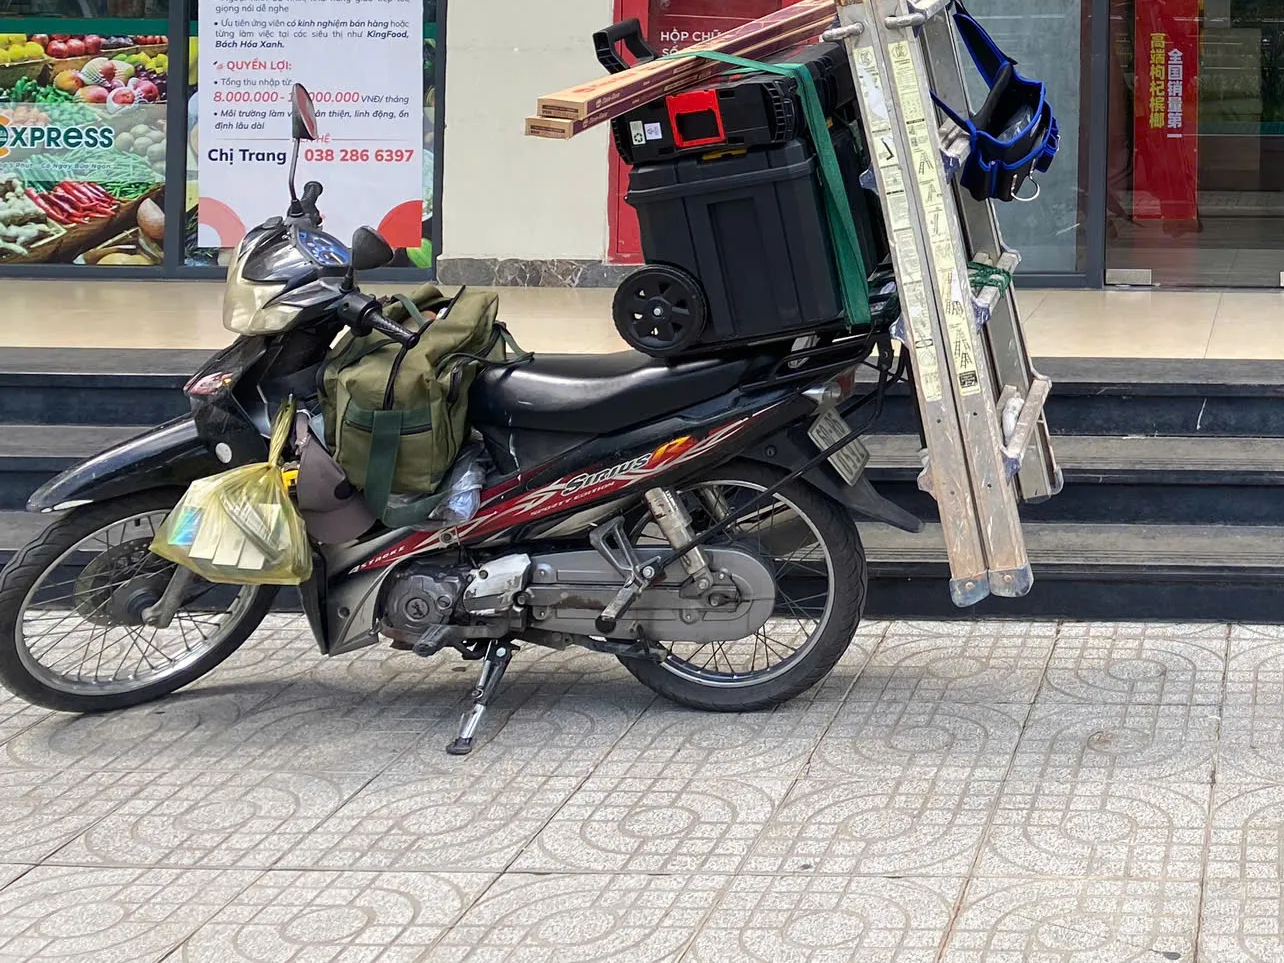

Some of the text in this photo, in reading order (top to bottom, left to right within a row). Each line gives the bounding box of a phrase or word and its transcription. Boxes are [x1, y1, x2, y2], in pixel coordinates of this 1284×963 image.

[268, 4, 289, 14] nghe
[287, 19, 296, 27] có
[298, 19, 315, 27] kinh
[349, 19, 366, 27] bán
[367, 19, 389, 30] hàng
[367, 30, 409, 40] KingFood,
[660, 26, 689, 44] HỘP
[215, 40, 285, 49] Bách Hóa Xanh.
[243, 78, 257, 86] thu
[213, 91, 279, 103] 8.000.000
[385, 95, 410, 105] tháng
[269, 109, 285, 117] làm
[354, 109, 370, 117] linh
[215, 122, 265, 131] định lâu dài
[207, 148, 414, 166] Chị Trang 038 286 6397
